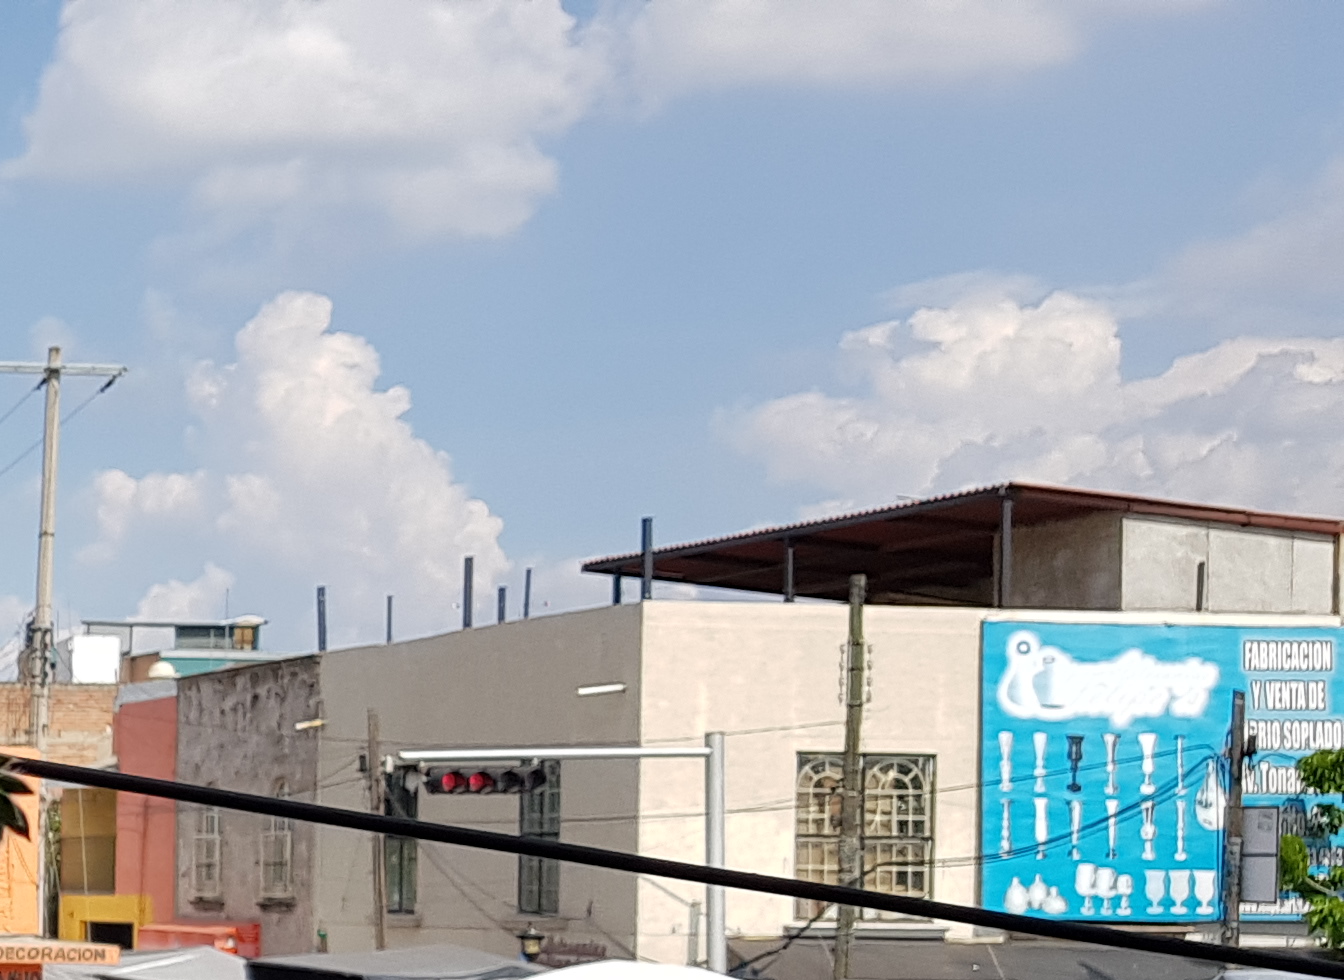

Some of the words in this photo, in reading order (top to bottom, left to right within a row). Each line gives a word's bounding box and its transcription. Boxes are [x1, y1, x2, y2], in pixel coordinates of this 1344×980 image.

[1243, 640, 1332, 671] FABRICACION
[1251, 680, 1262, 710] Y
[1265, 680, 1307, 711] VENTA
[1308, 680, 1326, 711] DE
[1282, 719, 1343, 751] SOPLADO
